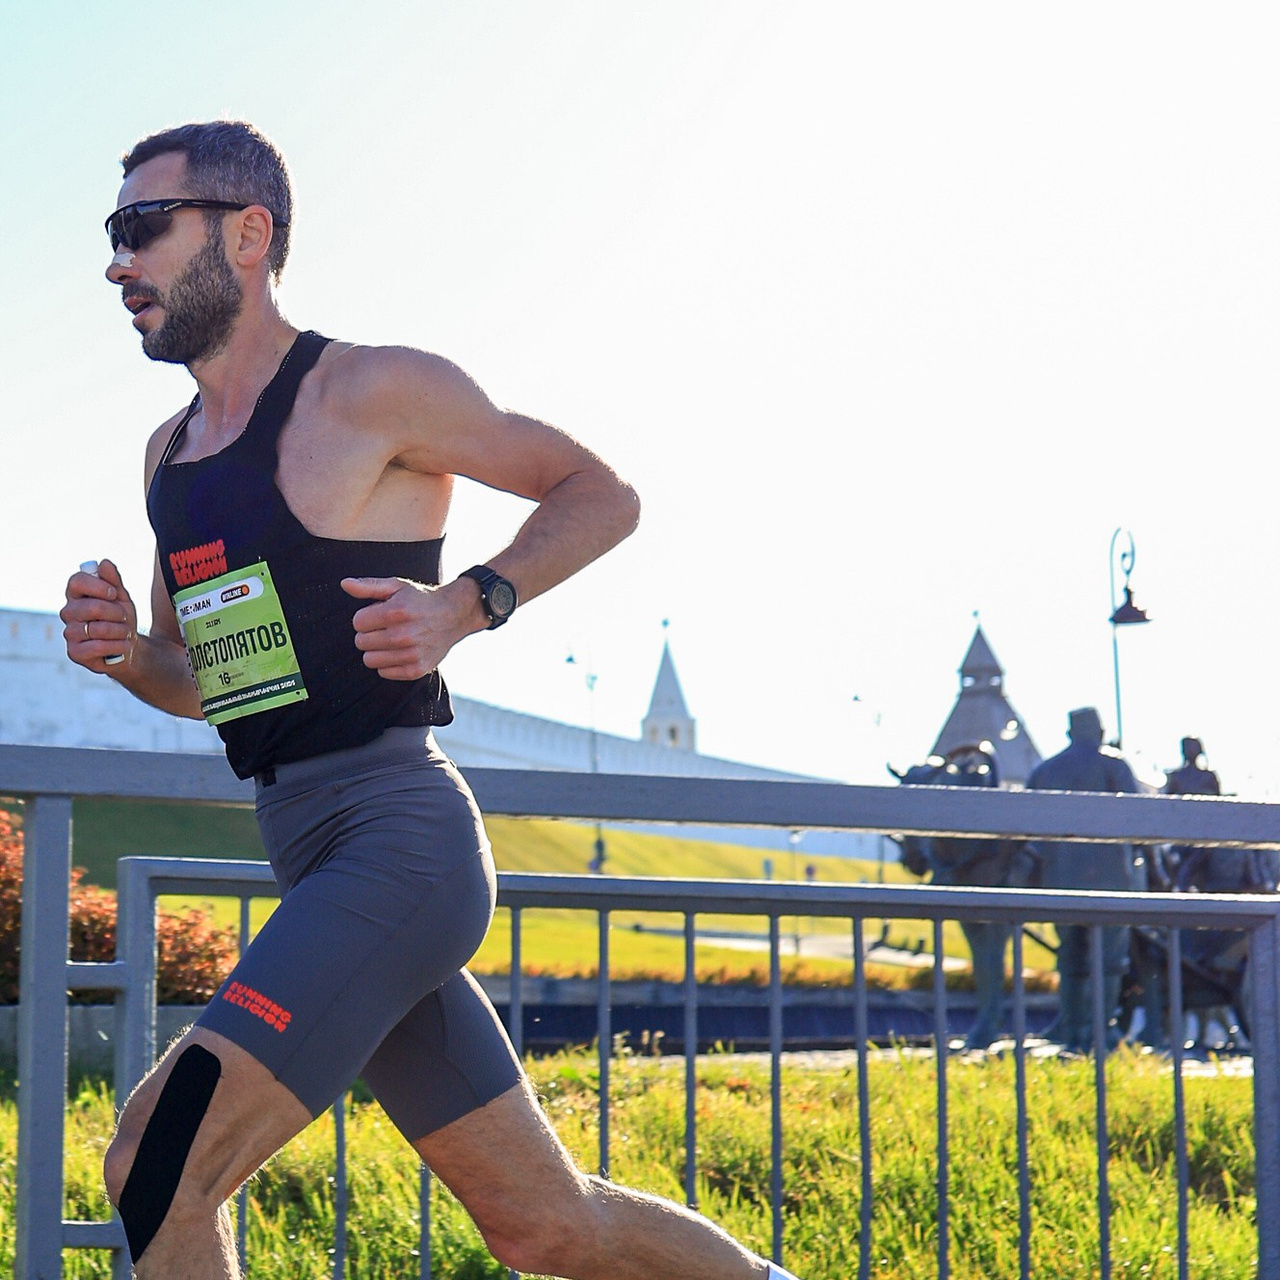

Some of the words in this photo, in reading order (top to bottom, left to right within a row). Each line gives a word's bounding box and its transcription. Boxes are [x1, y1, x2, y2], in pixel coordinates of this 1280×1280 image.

[189, 621, 288, 673] ОЛСТОПЯТОВ
[218, 672, 232, 686] 16
[222, 990, 287, 1033] RELIGION
[229, 981, 292, 1023] RUNNING
